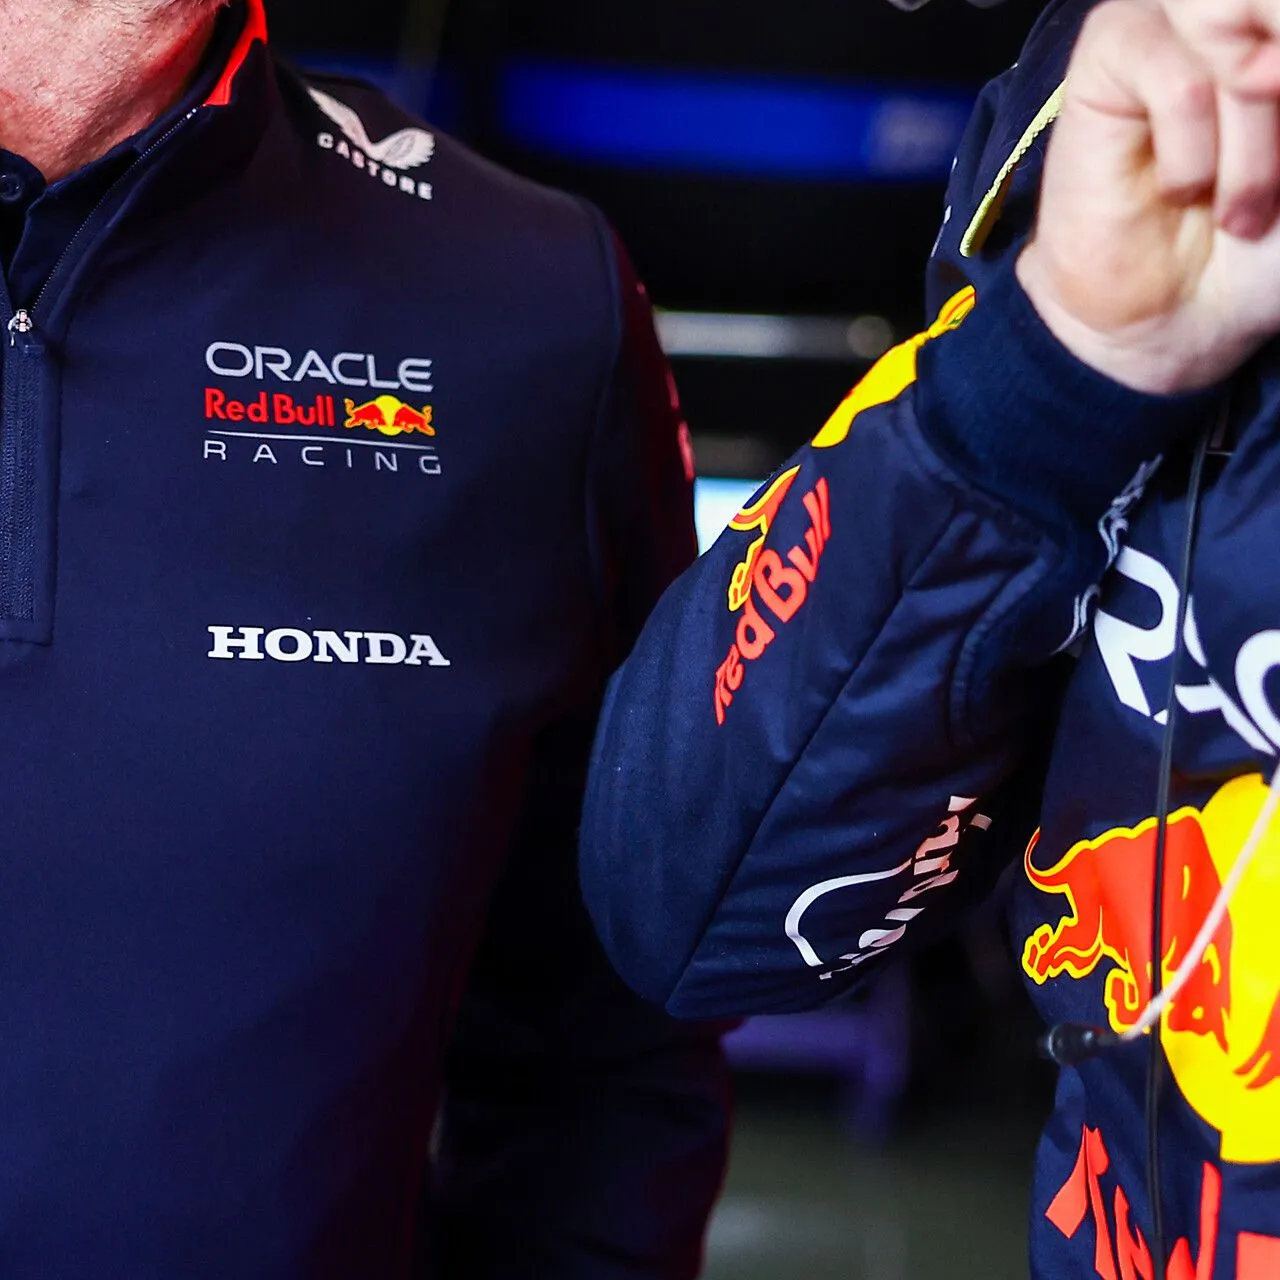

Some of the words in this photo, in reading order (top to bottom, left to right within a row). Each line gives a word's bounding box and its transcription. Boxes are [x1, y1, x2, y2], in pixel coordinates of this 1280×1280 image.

[317, 131, 433, 201] CASTORE
[205, 341, 434, 393] ORACLE
[204, 387, 269, 423] Red
[272, 393, 336, 428] Bull
[203, 439, 442, 475] RACING
[753, 476, 832, 623] Bull
[206, 624, 451, 667] HONDA
